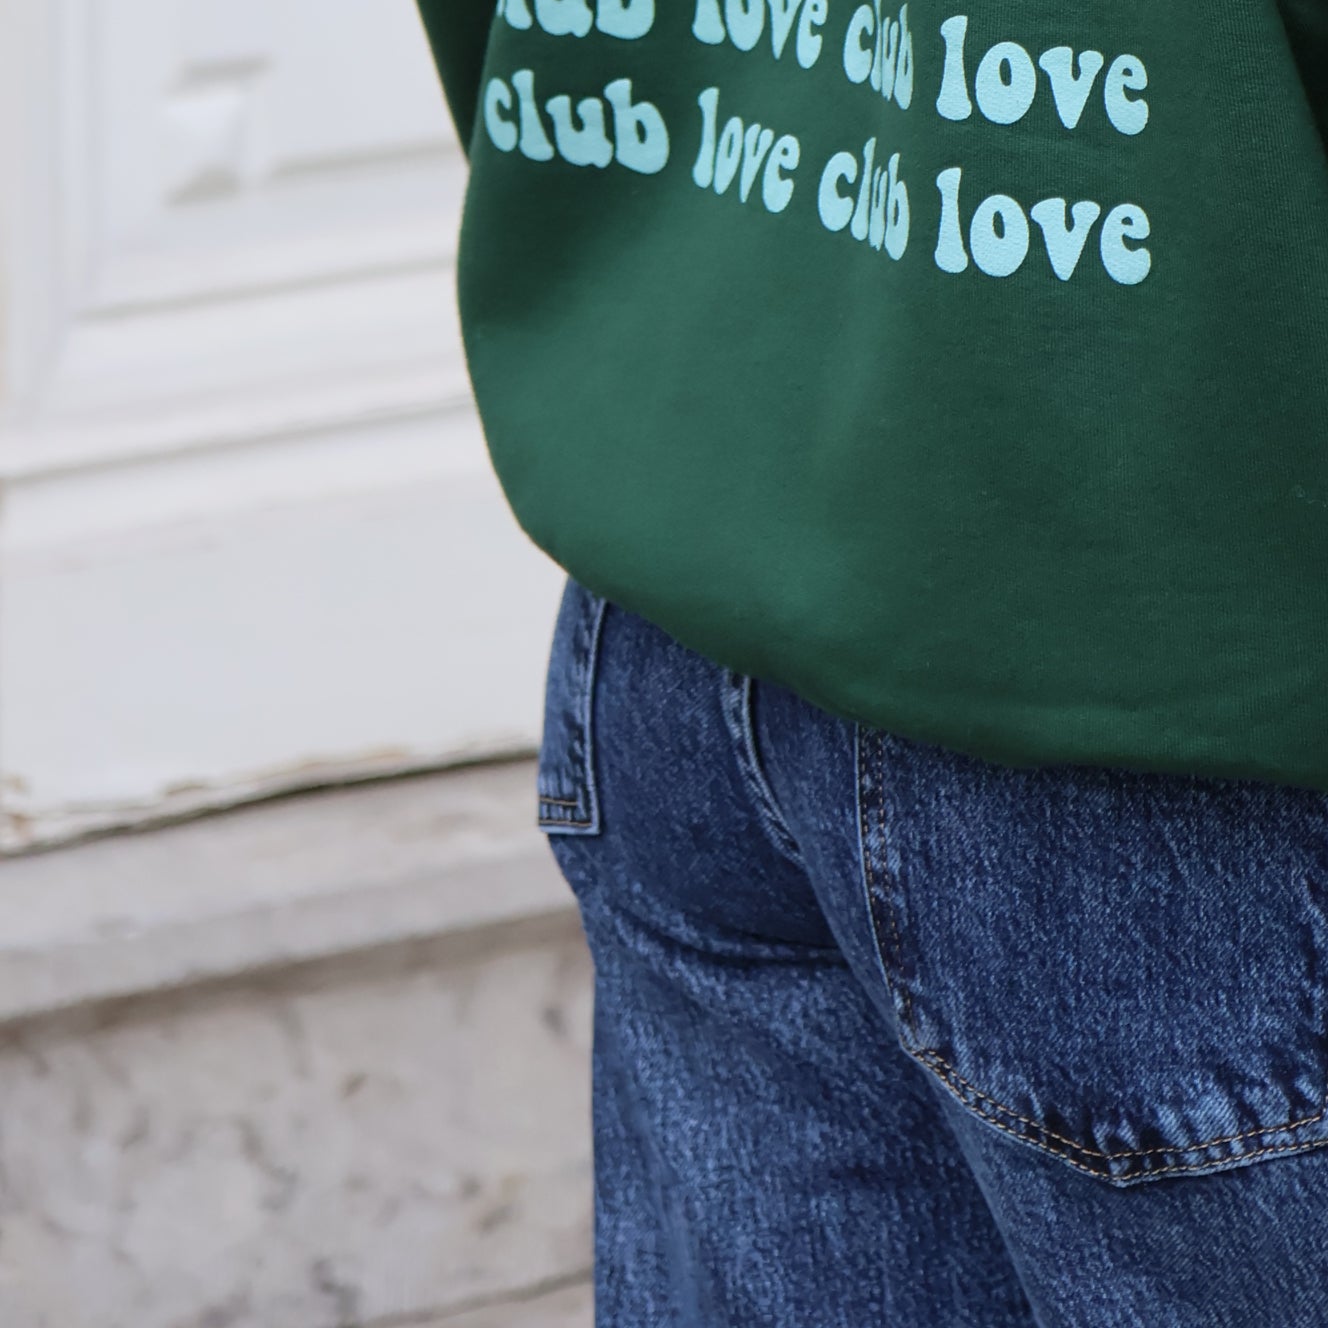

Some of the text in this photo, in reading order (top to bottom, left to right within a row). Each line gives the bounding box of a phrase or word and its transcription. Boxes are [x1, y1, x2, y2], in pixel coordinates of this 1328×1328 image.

[935, 14, 1149, 136] love
[484, 69, 1152, 285] club love club love
